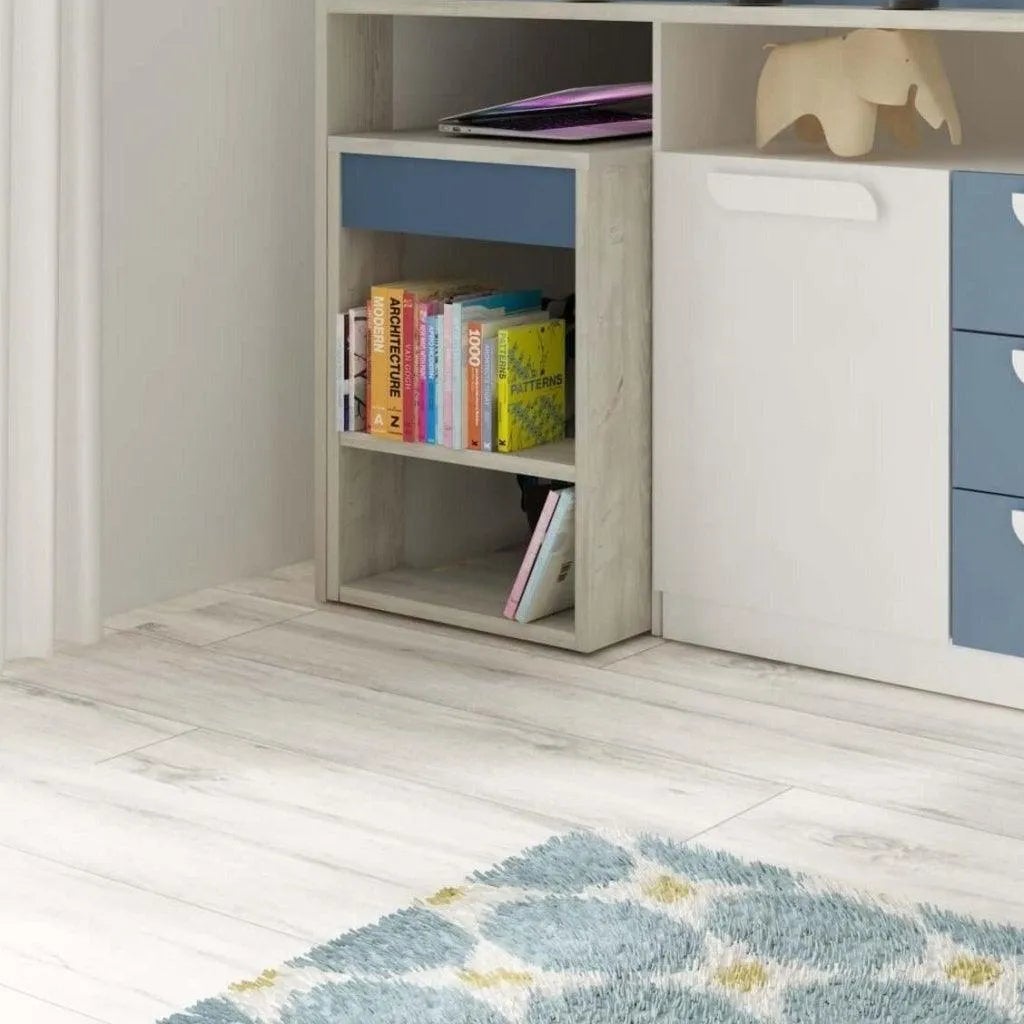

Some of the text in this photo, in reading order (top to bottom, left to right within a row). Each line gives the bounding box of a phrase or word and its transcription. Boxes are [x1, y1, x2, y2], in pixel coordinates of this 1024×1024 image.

[373, 296, 385, 353] MODERN
[389, 297, 401, 398] ARCHITECTURE
[469, 328, 481, 368] 1000
[511, 374, 563, 394] PATTERNS
